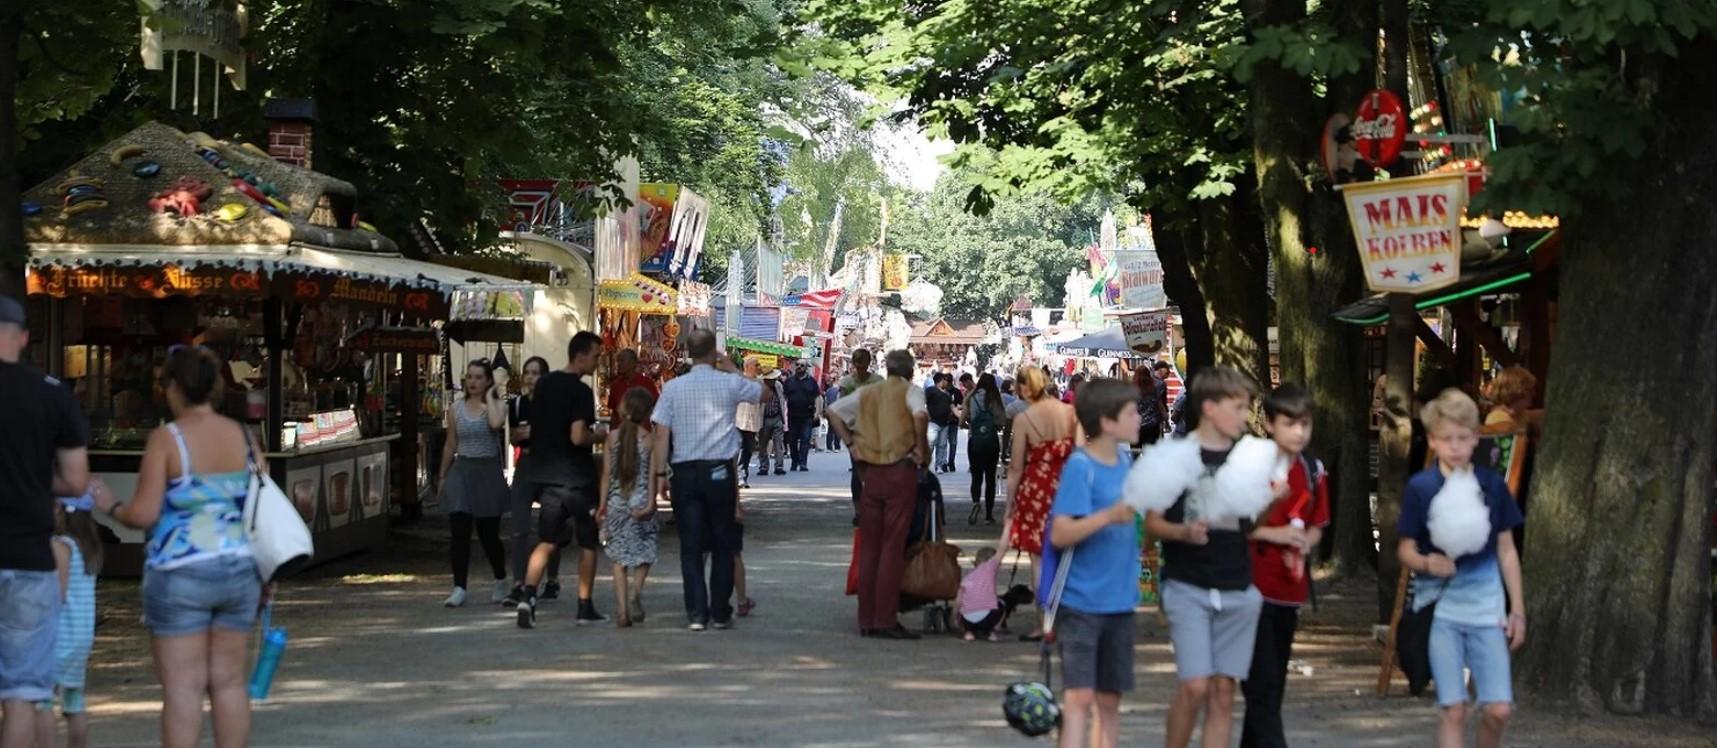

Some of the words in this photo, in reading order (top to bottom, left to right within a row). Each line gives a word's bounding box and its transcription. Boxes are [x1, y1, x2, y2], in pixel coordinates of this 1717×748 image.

[1363, 194, 1449, 232] MAIS
[1366, 229, 1452, 262] KOLBEN
[47, 266, 127, 297] Früchte
[160, 264, 224, 296] Nüsse
[329, 278, 398, 305] Mandeln
